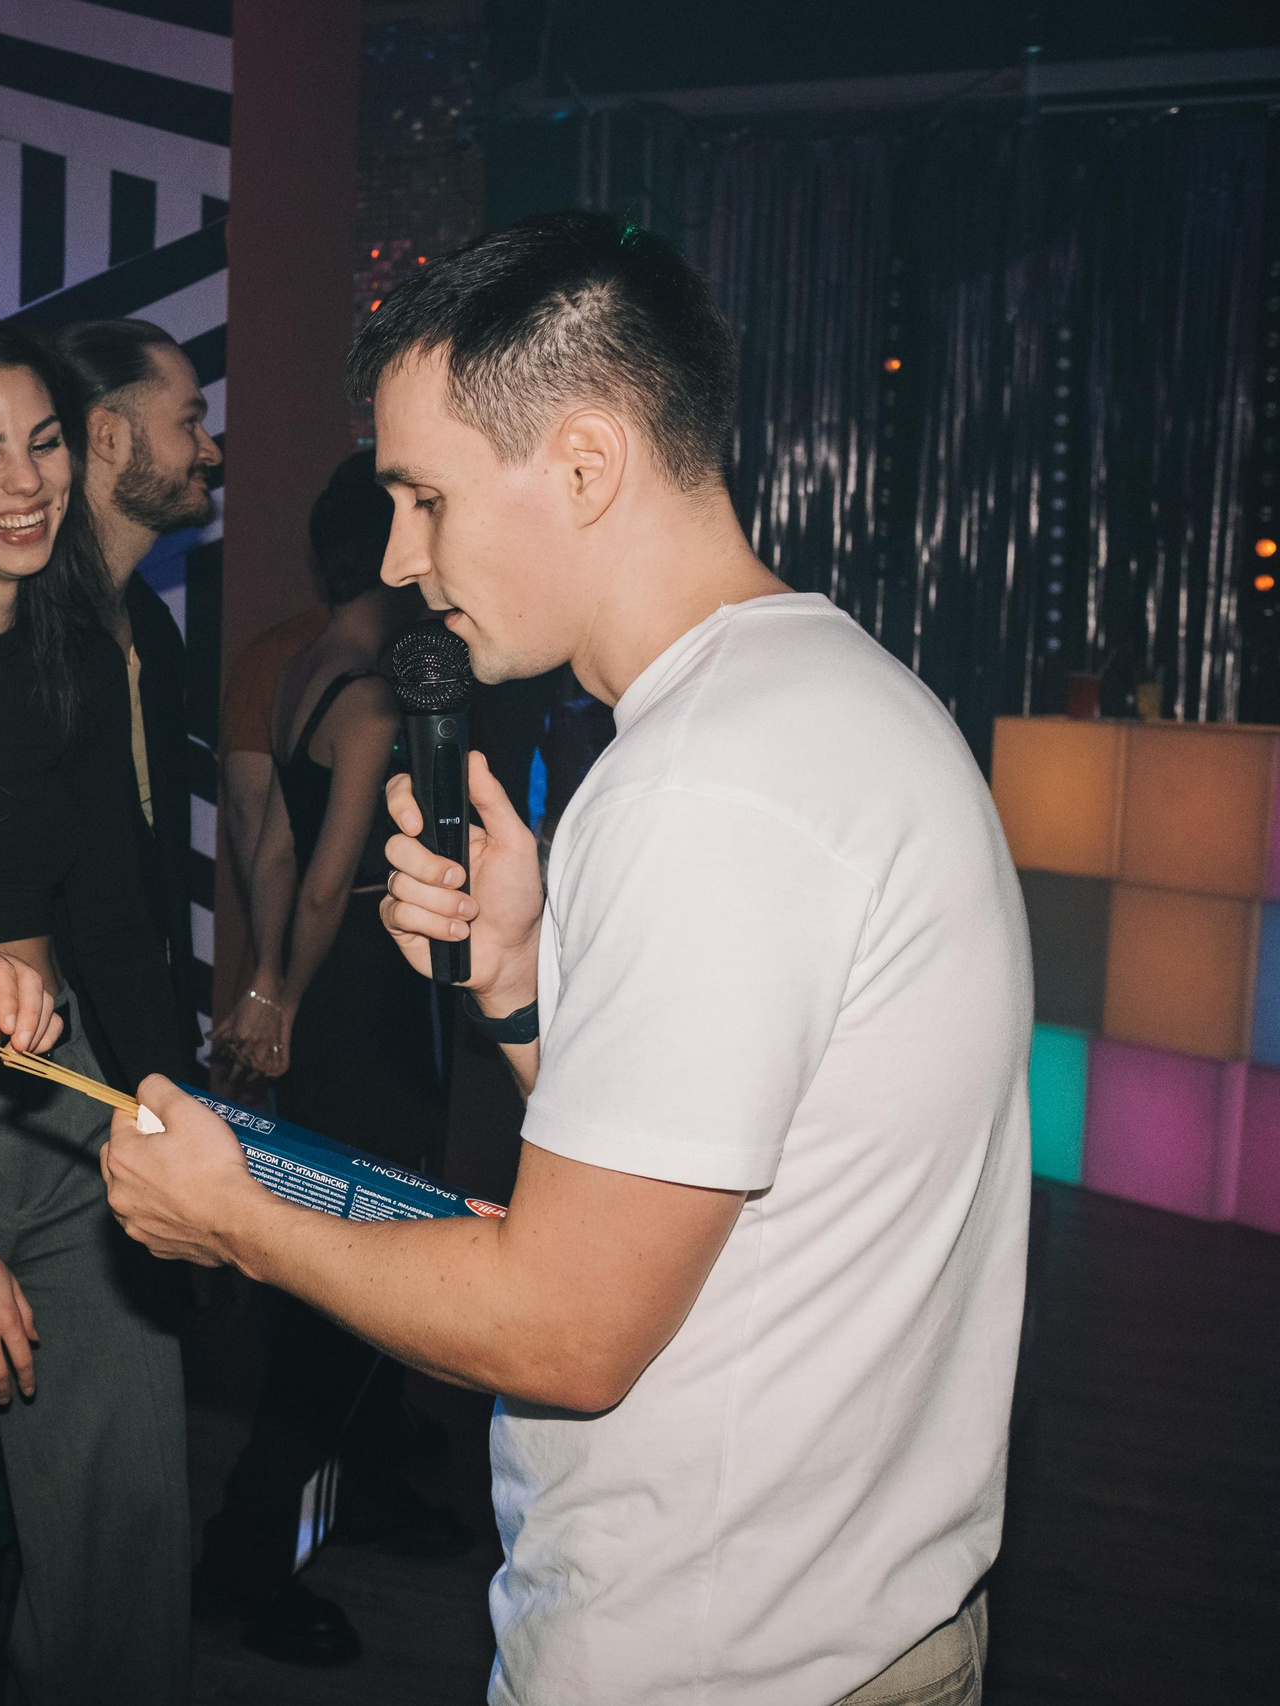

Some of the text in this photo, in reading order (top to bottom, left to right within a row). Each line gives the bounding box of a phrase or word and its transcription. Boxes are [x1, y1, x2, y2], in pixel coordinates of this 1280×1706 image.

[246, 1148, 350, 1191] ВКУСОМ ПО-ИТАЛЬЯНСКИ:
[371, 1165, 459, 1201] SPAGHETTONI
[471, 1201, 507, 1218] arilla
